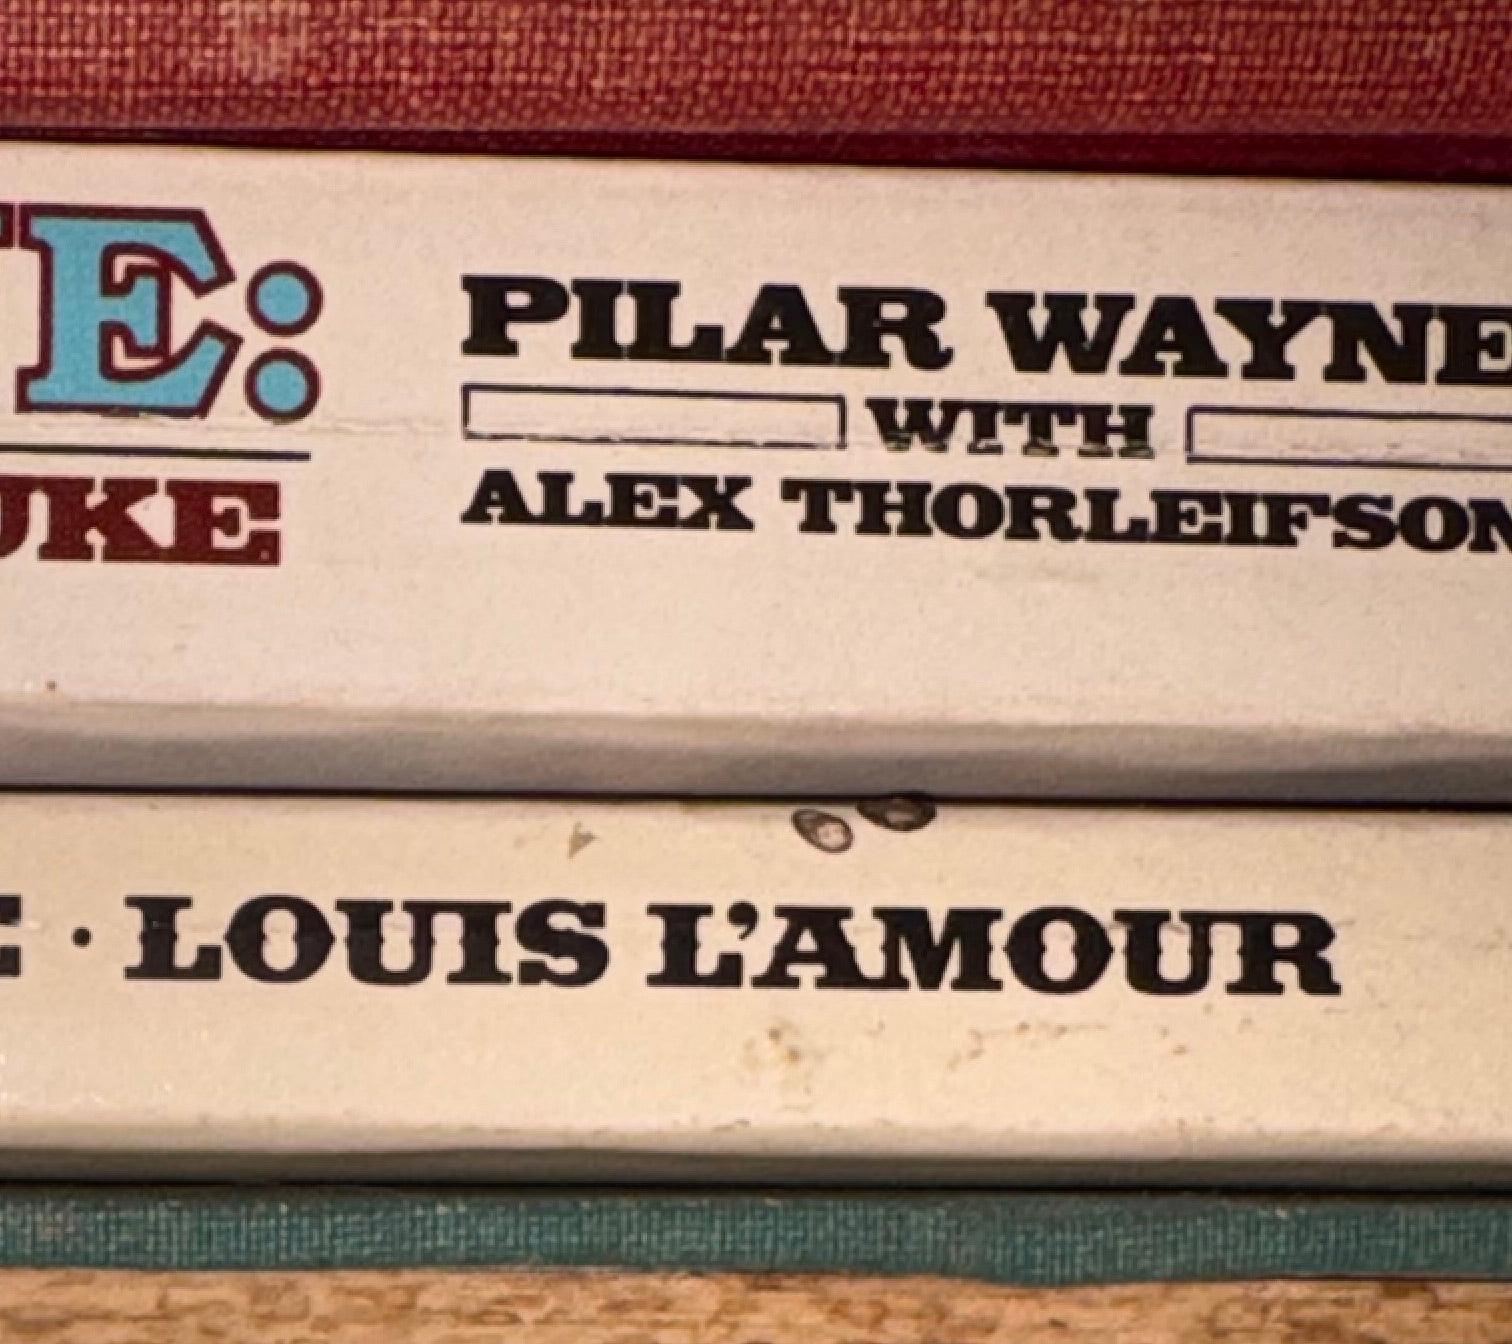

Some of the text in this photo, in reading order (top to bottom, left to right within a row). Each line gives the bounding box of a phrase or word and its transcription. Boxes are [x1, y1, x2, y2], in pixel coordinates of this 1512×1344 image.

[461, 274, 1512, 388] PILAR WAYNE
[864, 398, 1155, 460] WITH
[460, 470, 1512, 554] ALEX THORLEIFSON
[124, 894, 611, 988] LOUIS
[645, 900, 1343, 996] L'AMOUR
